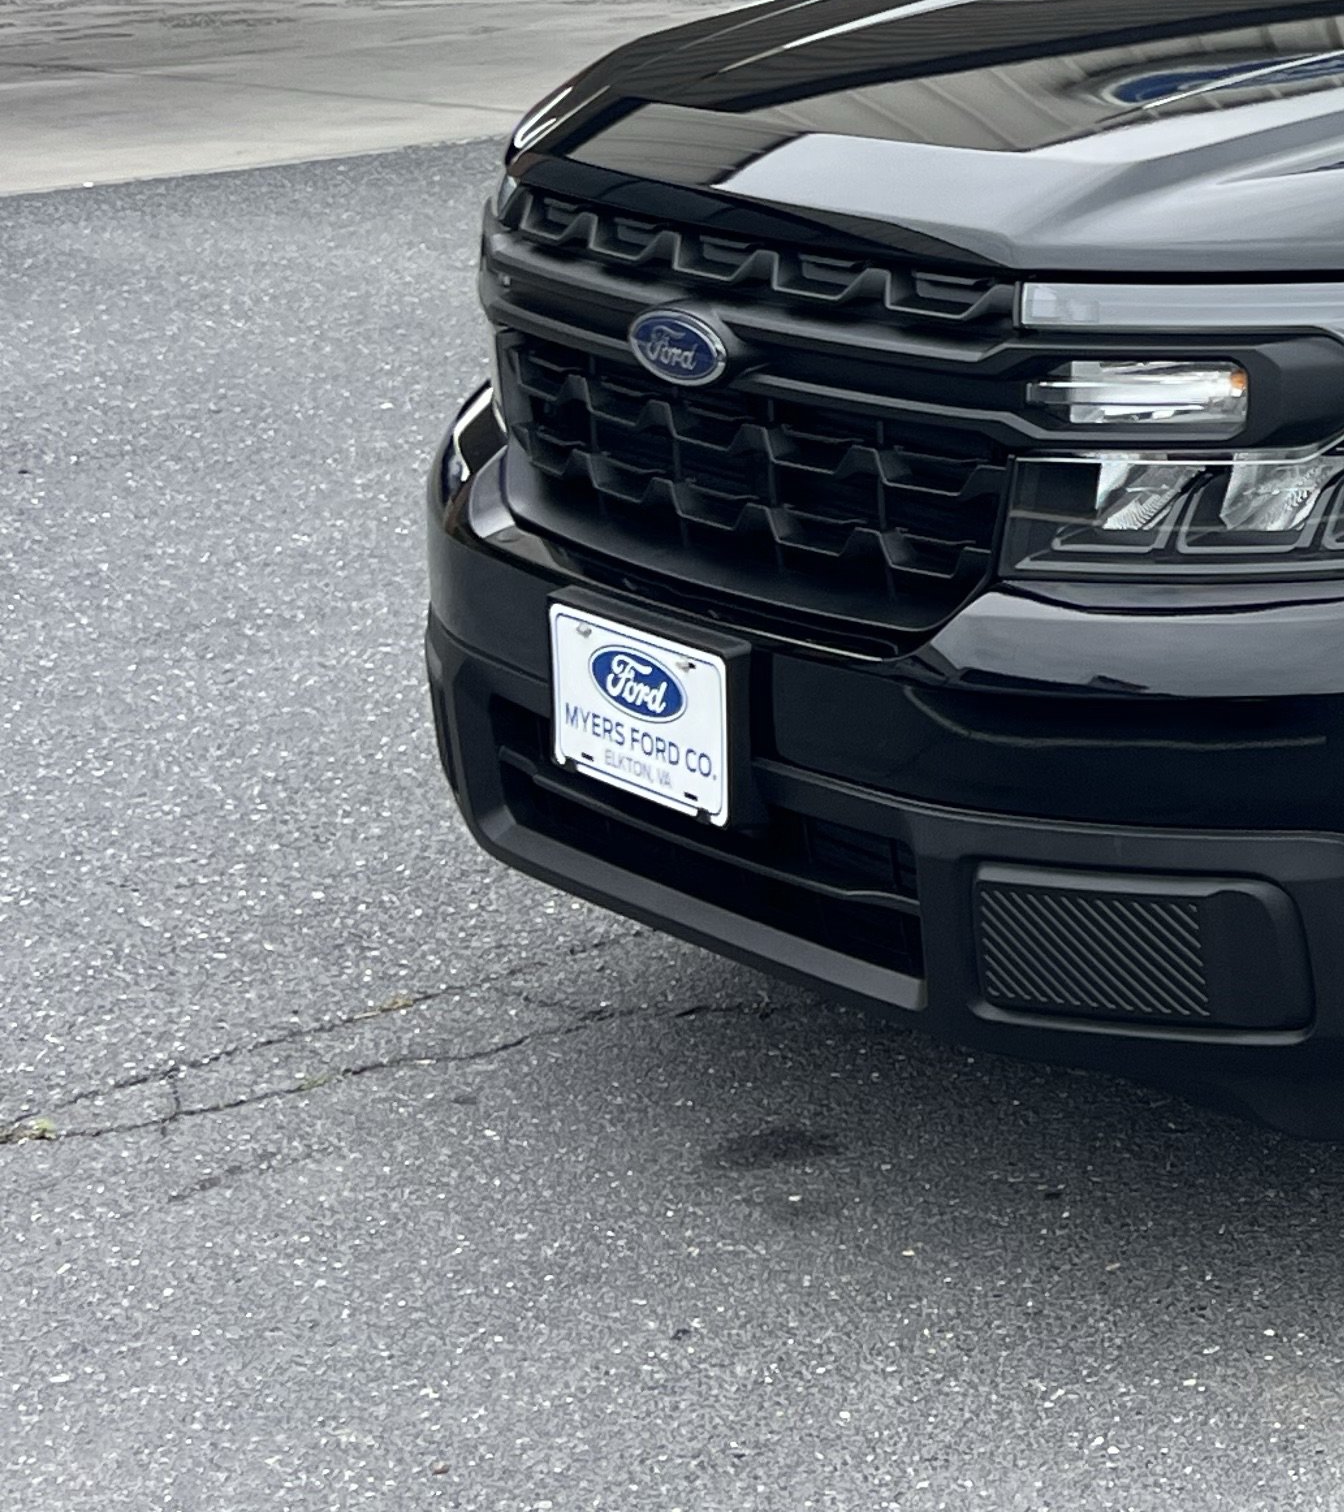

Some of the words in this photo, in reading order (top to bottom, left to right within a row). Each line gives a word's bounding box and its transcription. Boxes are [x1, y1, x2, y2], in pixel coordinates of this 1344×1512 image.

[644, 325, 698, 370] Ford
[605, 654, 668, 714] Ford
[564, 702, 626, 746] MYERS
[630, 726, 680, 766] FORD
[685, 748, 718, 781] CO.
